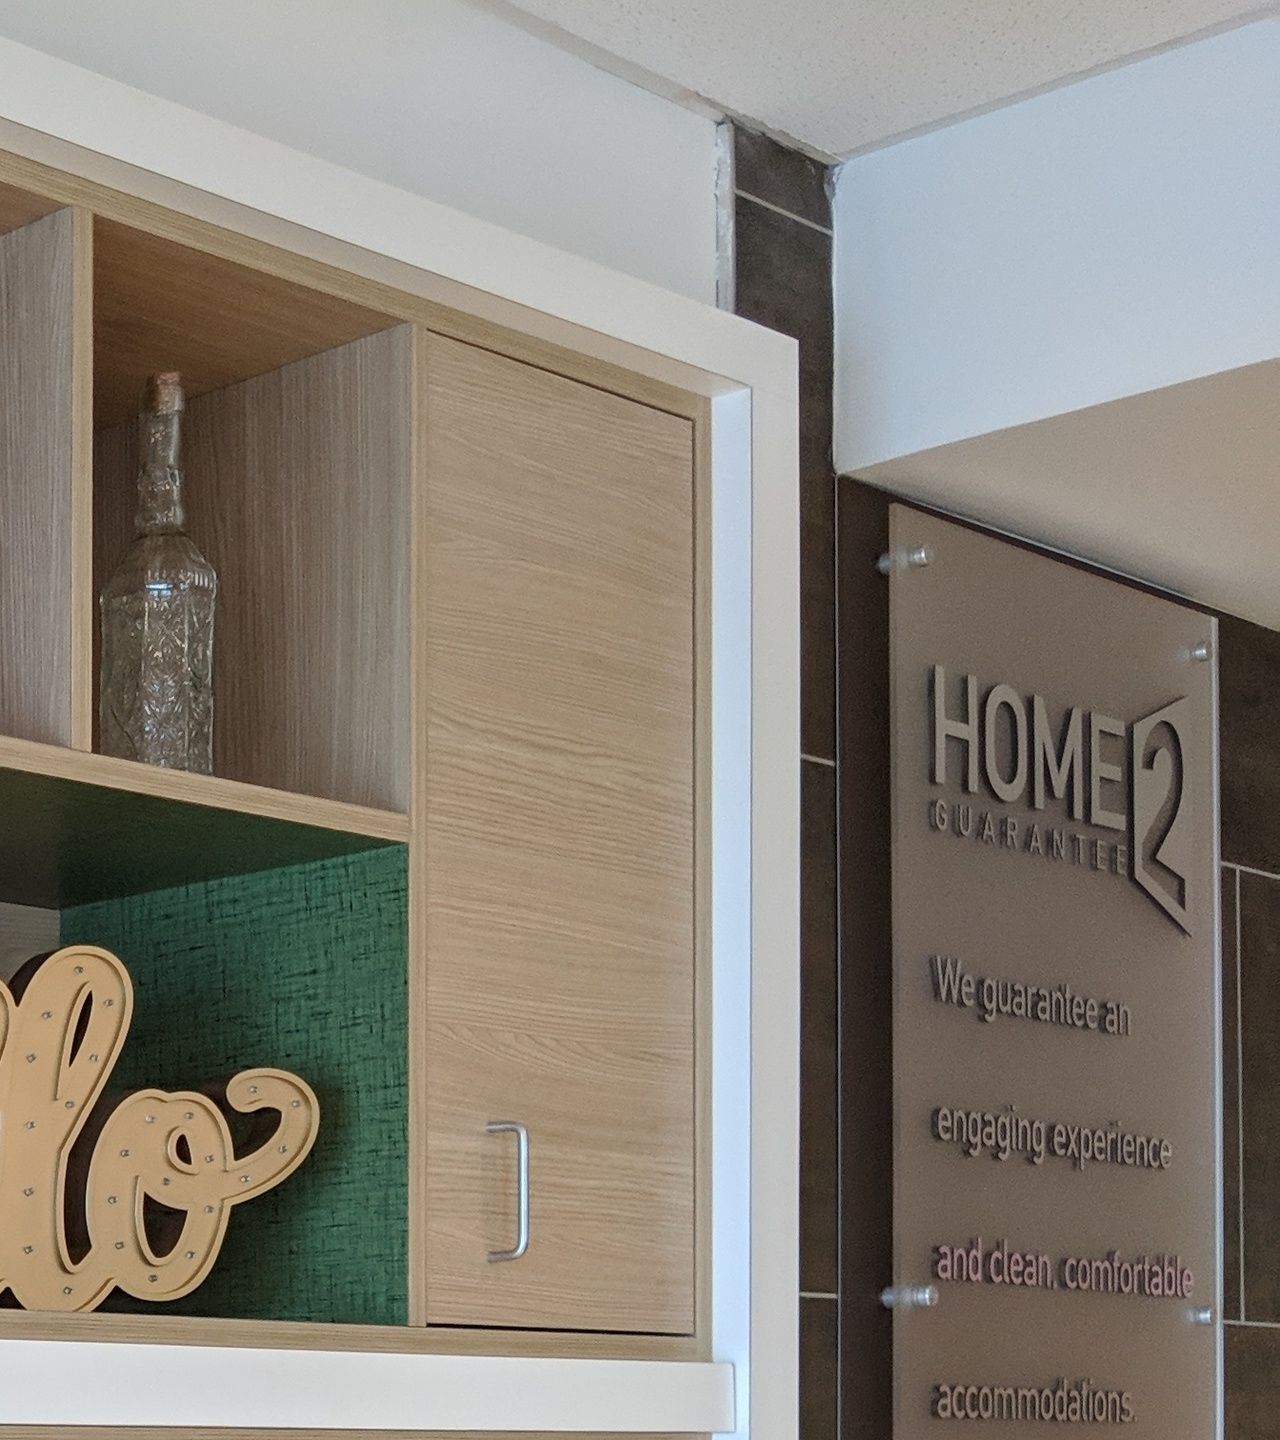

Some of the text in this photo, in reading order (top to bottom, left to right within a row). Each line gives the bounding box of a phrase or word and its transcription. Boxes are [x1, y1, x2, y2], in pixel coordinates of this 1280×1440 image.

[931, 800, 1129, 876] GUARANTEE
[931, 954, 1132, 1036] We guarantee an
[934, 1104, 1172, 1170] engaging experience
[936, 1237, 983, 1284] and
[1062, 1250, 1194, 1299] comfortable
[935, 1377, 1138, 1424] accommodations.
